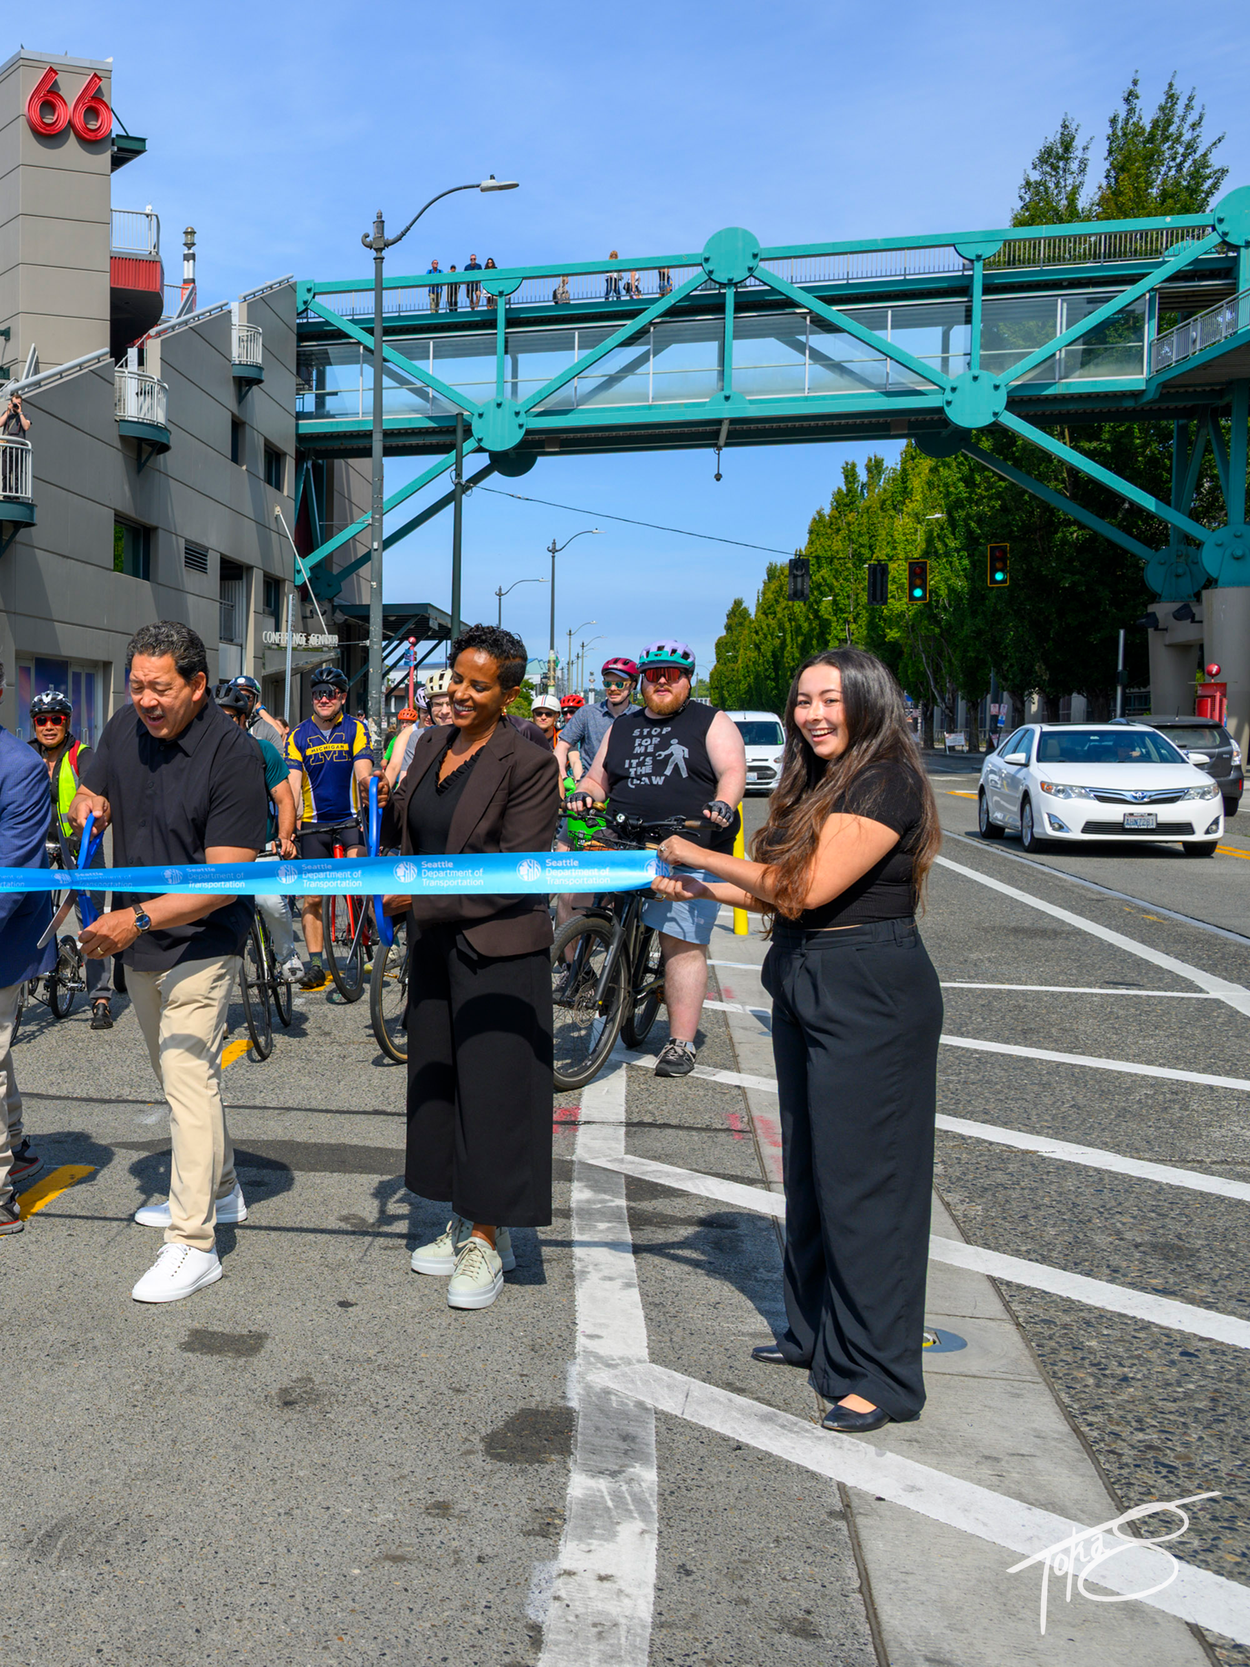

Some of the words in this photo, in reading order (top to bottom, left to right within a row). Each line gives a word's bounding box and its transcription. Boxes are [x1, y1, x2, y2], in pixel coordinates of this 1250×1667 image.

[25, 65, 113, 142] 66
[632, 727, 672, 737] STOP
[634, 737, 661, 747] FOR
[310, 744, 346, 754] MICHIGAN
[633, 745, 655, 754] ME
[624, 756, 653, 768] IT'S
[629, 765, 653, 777] THE
[421, 860, 454, 868] Seattle
[546, 858, 579, 867] Seattle
[302, 870, 351, 880] Department
[352, 870, 362, 878] of
[421, 868, 472, 878] Department
[473, 868, 484, 877] of
[546, 867, 600, 877] Department
[600, 867, 611, 876] of
[188, 880, 246, 889] Transportation
[302, 879, 363, 889] Transportation
[422, 878, 484, 887] Transportation
[546, 876, 611, 886] Transportation
